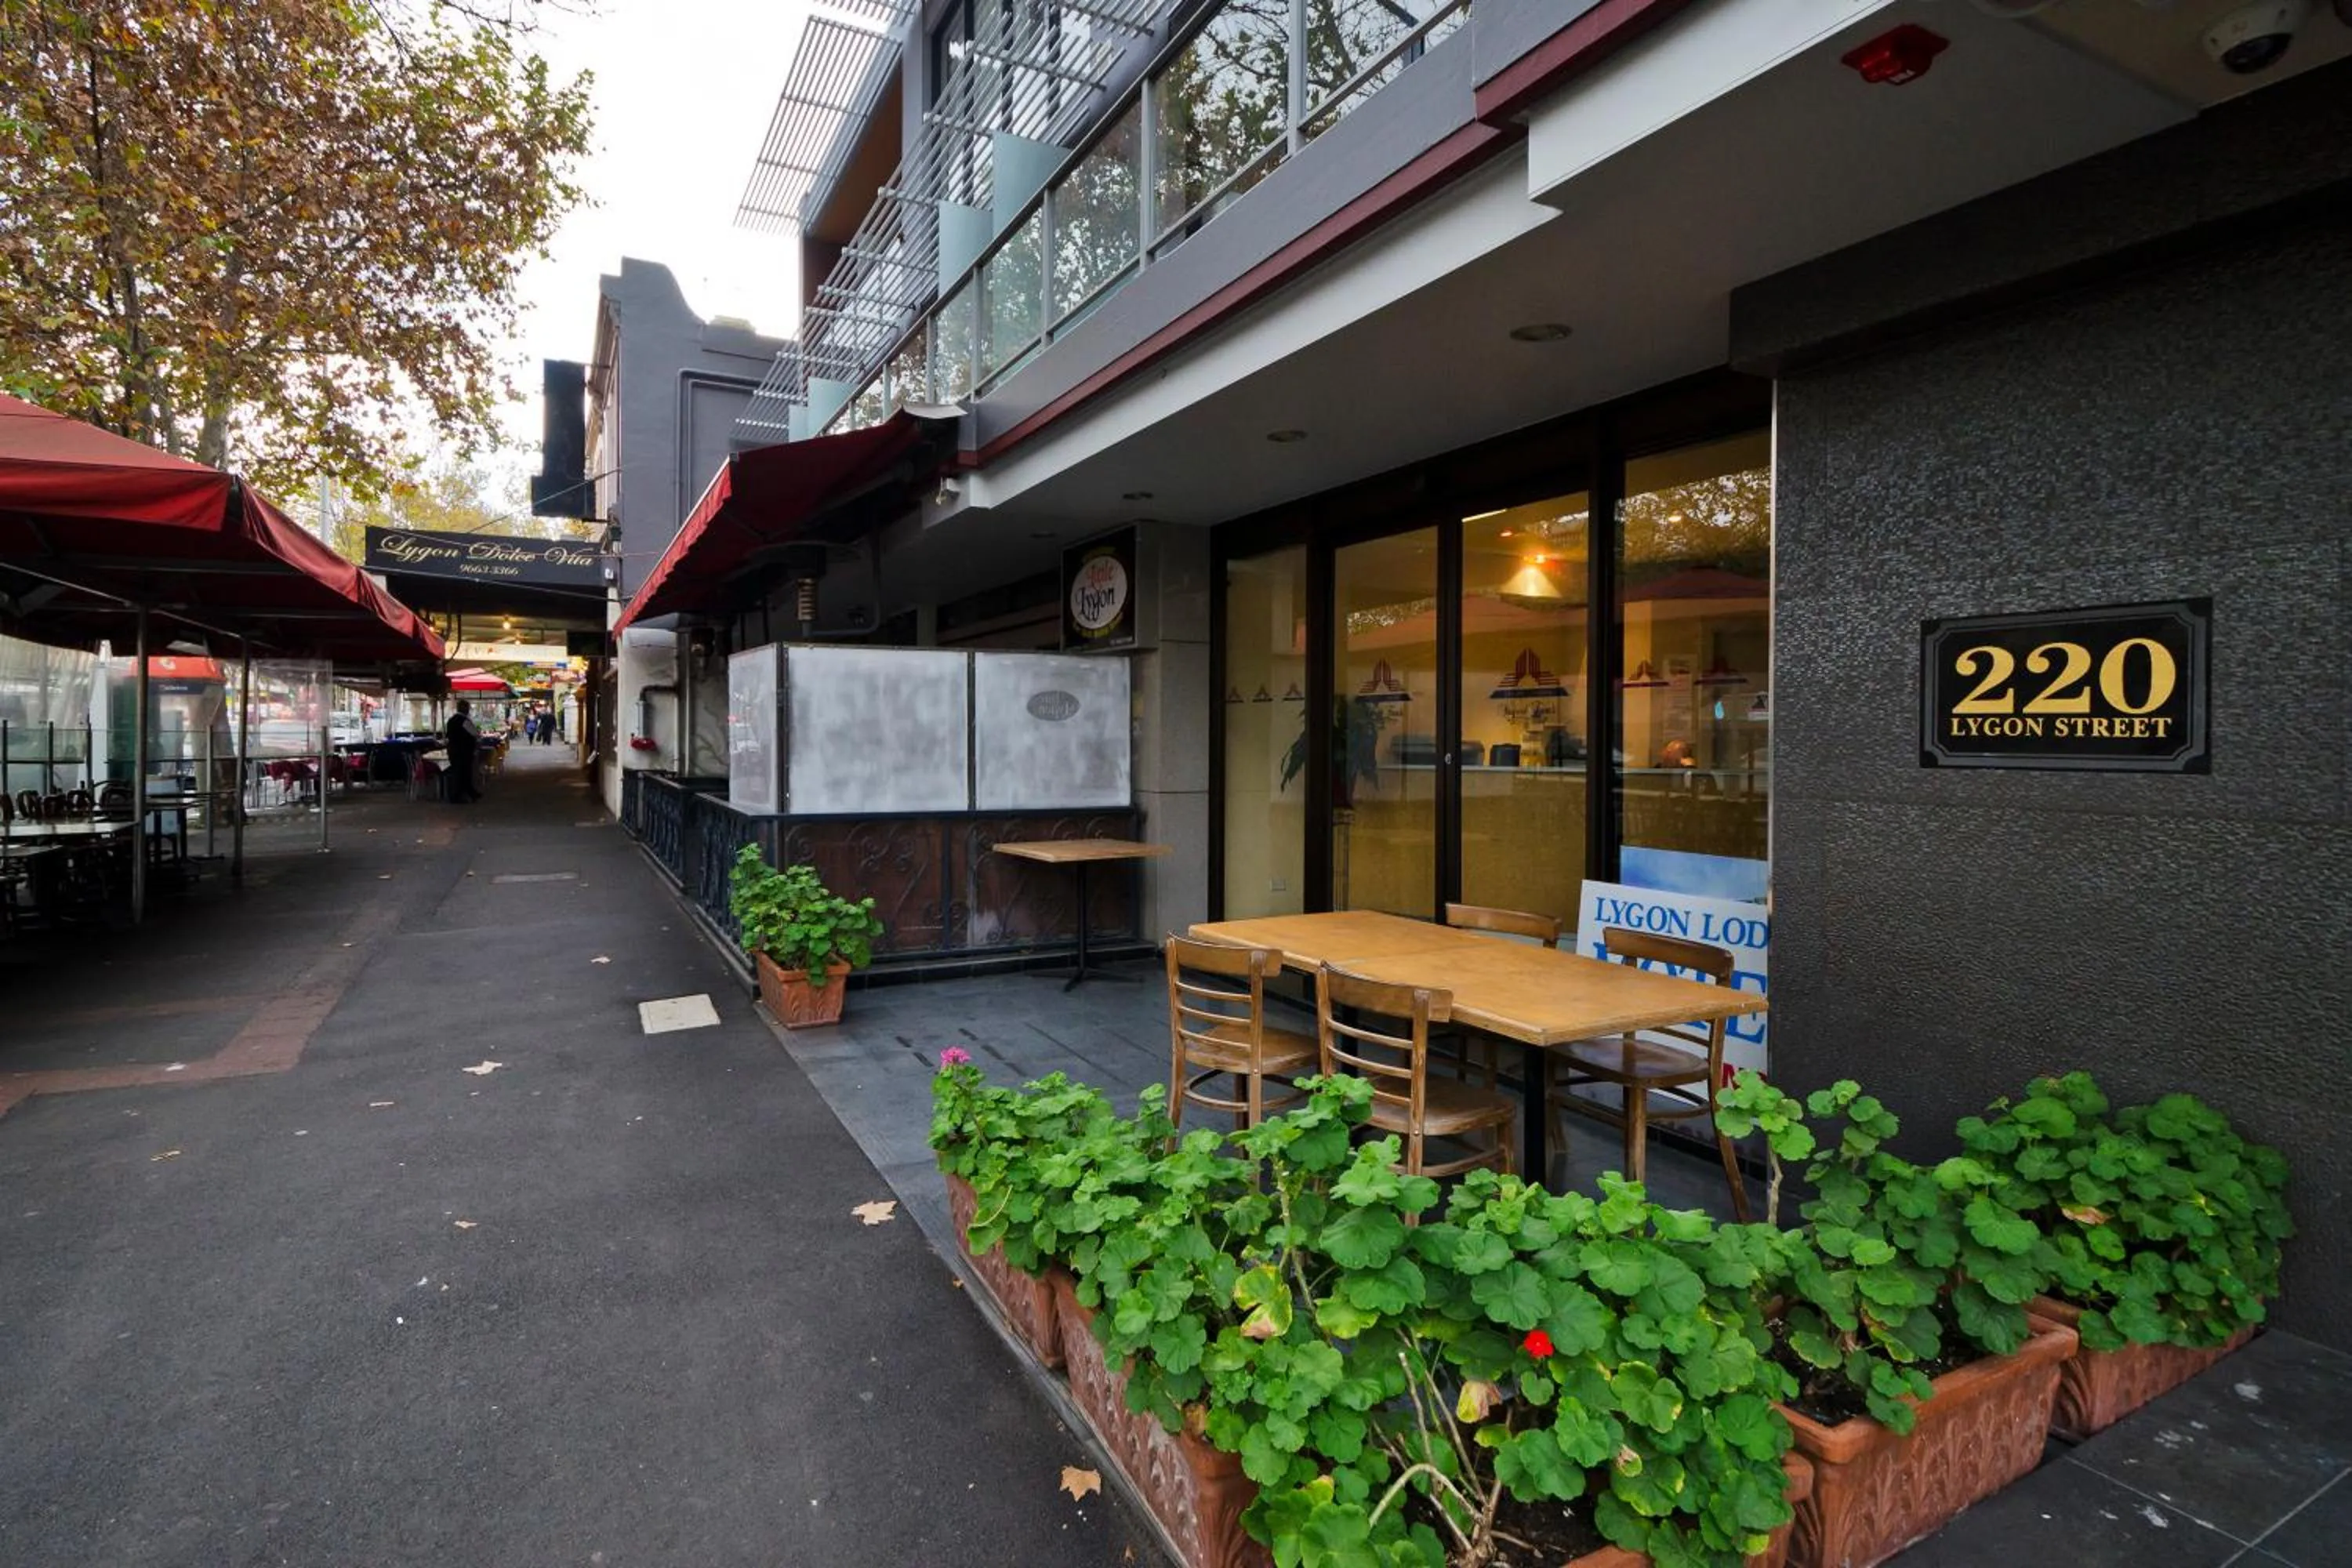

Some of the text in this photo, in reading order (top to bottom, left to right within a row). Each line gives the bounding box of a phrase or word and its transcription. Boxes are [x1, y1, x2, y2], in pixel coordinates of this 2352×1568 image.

[376, 534, 599, 567] Lygon Dolce Vita
[1951, 637, 2176, 714] 220
[1950, 717, 2172, 739] LYGON STREET
[1595, 896, 1691, 936] LYGON
